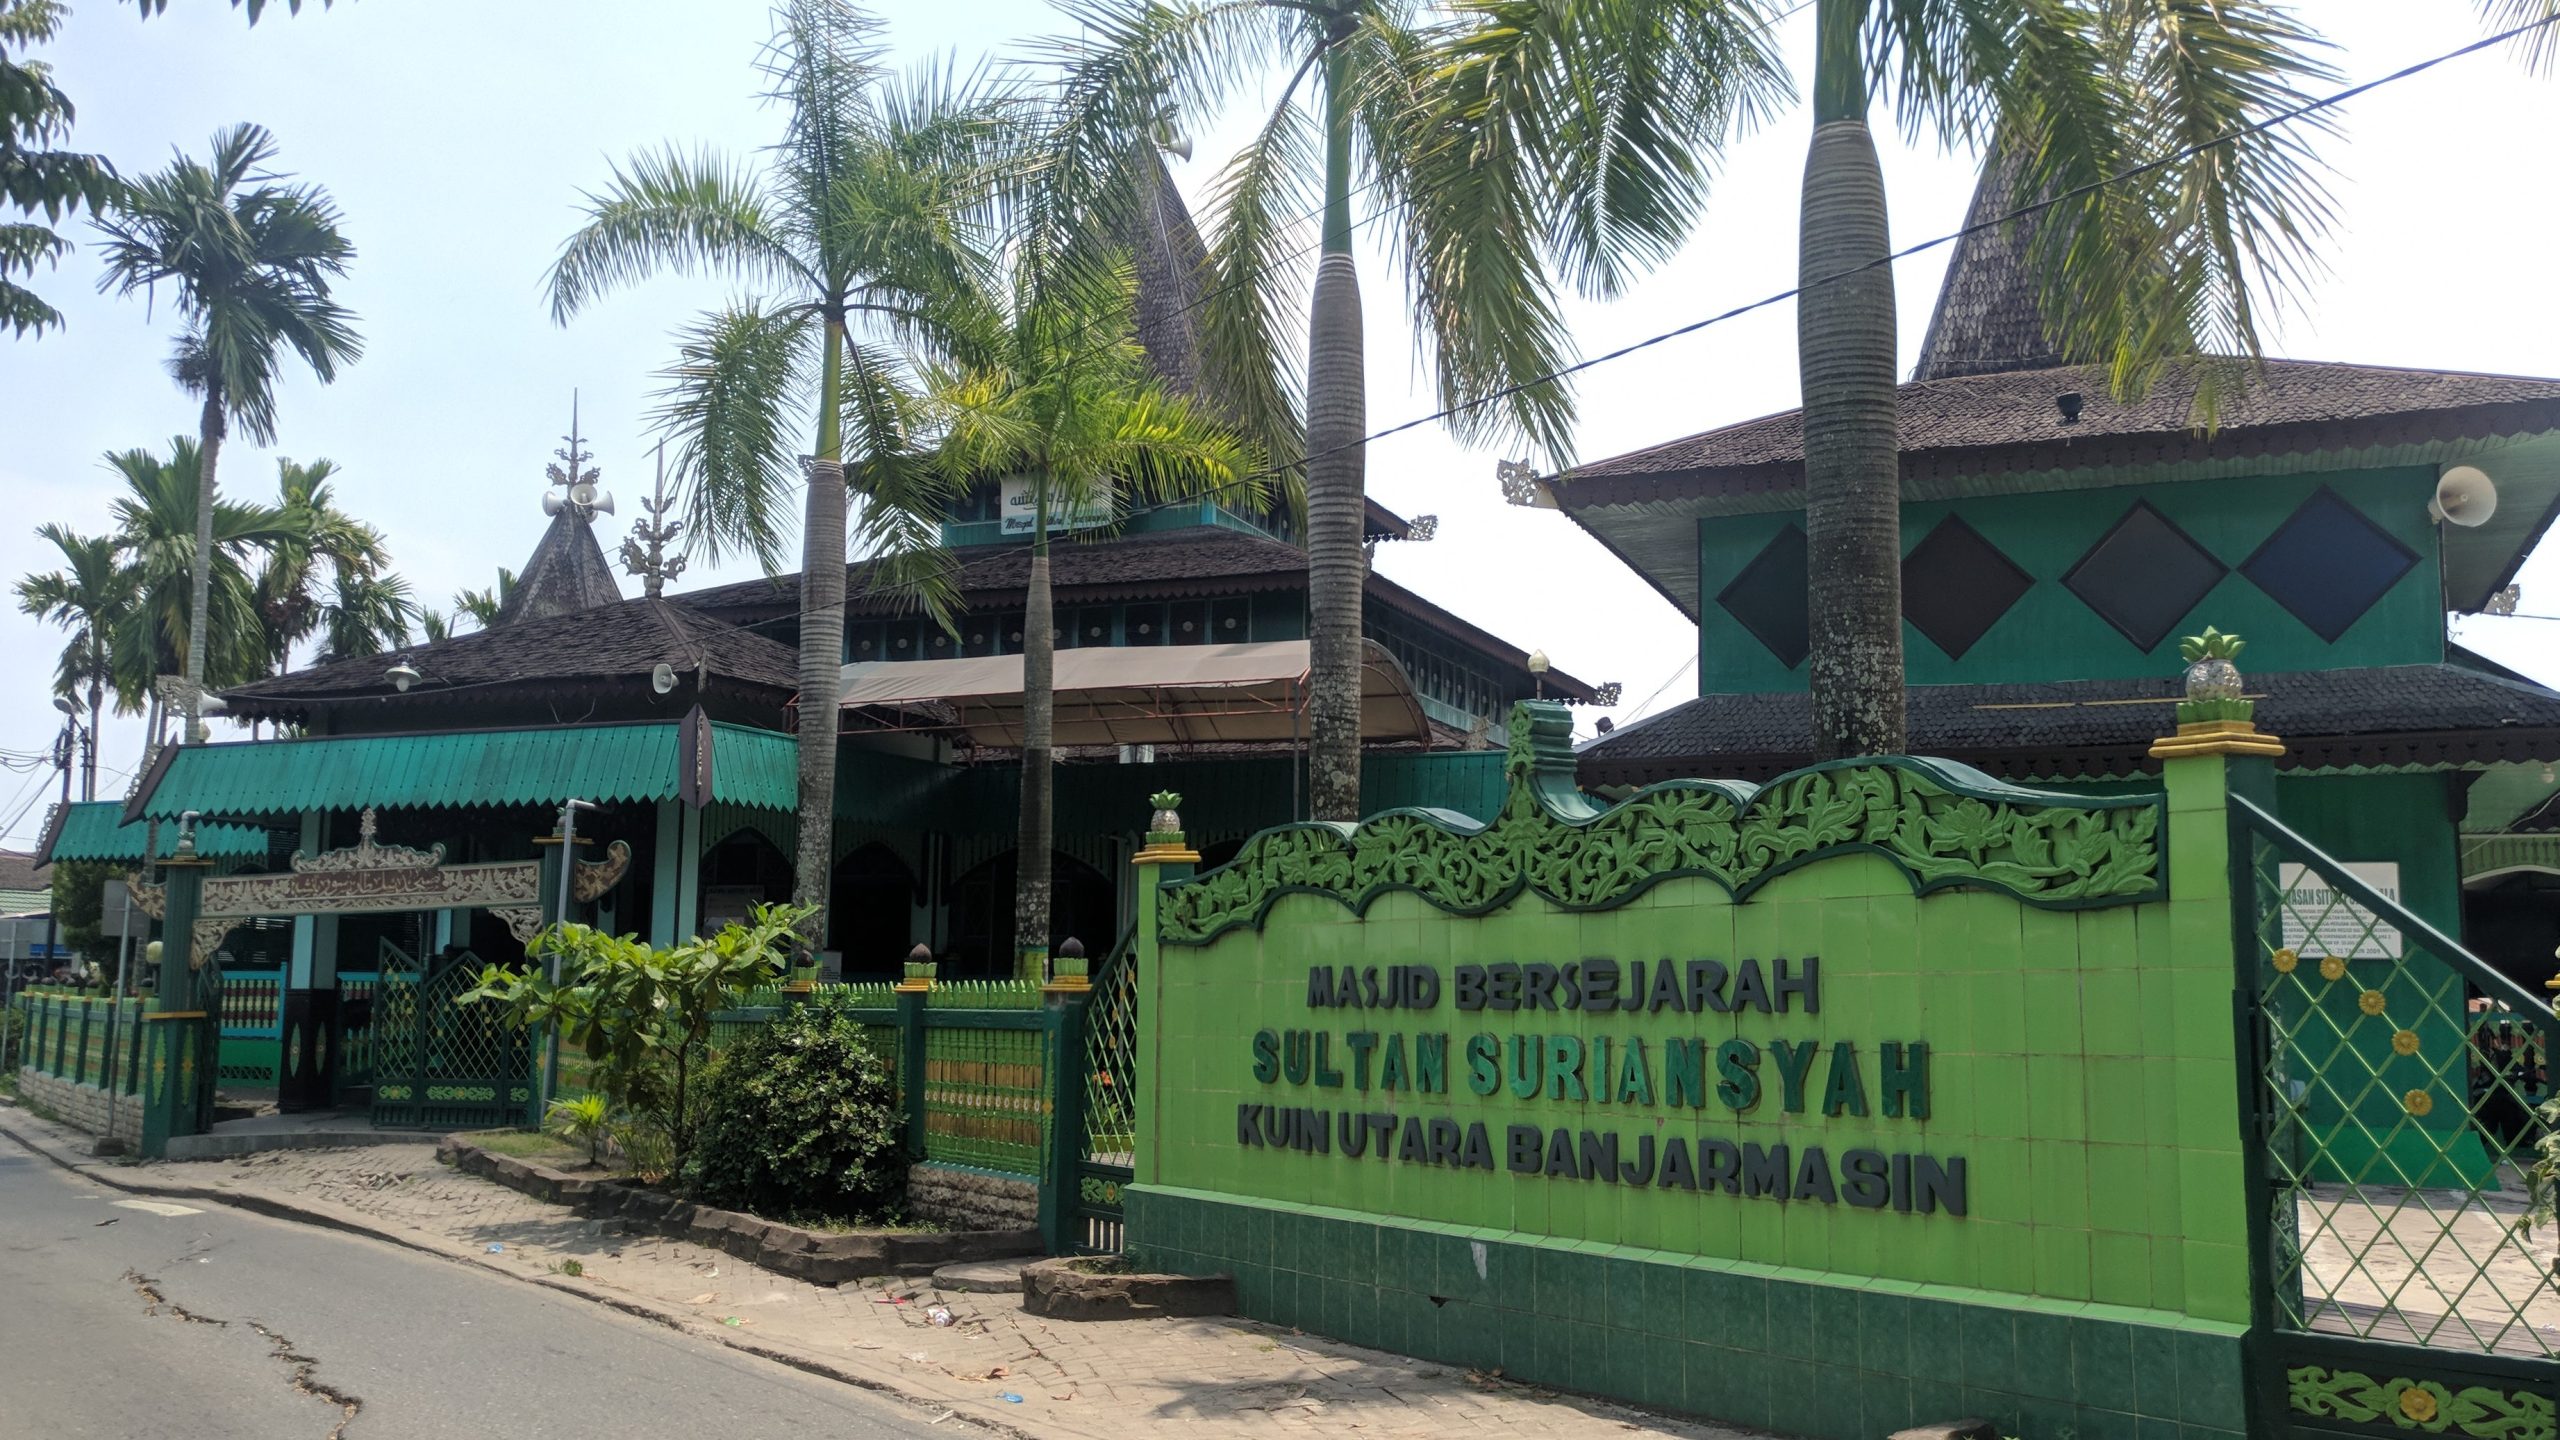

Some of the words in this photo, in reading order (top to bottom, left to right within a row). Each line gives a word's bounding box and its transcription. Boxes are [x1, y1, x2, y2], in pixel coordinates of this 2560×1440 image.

[1307, 966, 1440, 1009] MASJID
[1455, 956, 1820, 1014] BERSEJARAH
[1252, 1028, 1447, 1094] SULTAN
[1466, 1032, 1930, 1119] SURIANSYAH
[1237, 1104, 1329, 1154] KUIN
[1337, 1111, 1494, 1171] UTARA
[1507, 1124, 1967, 1216] BANJARMASIN
